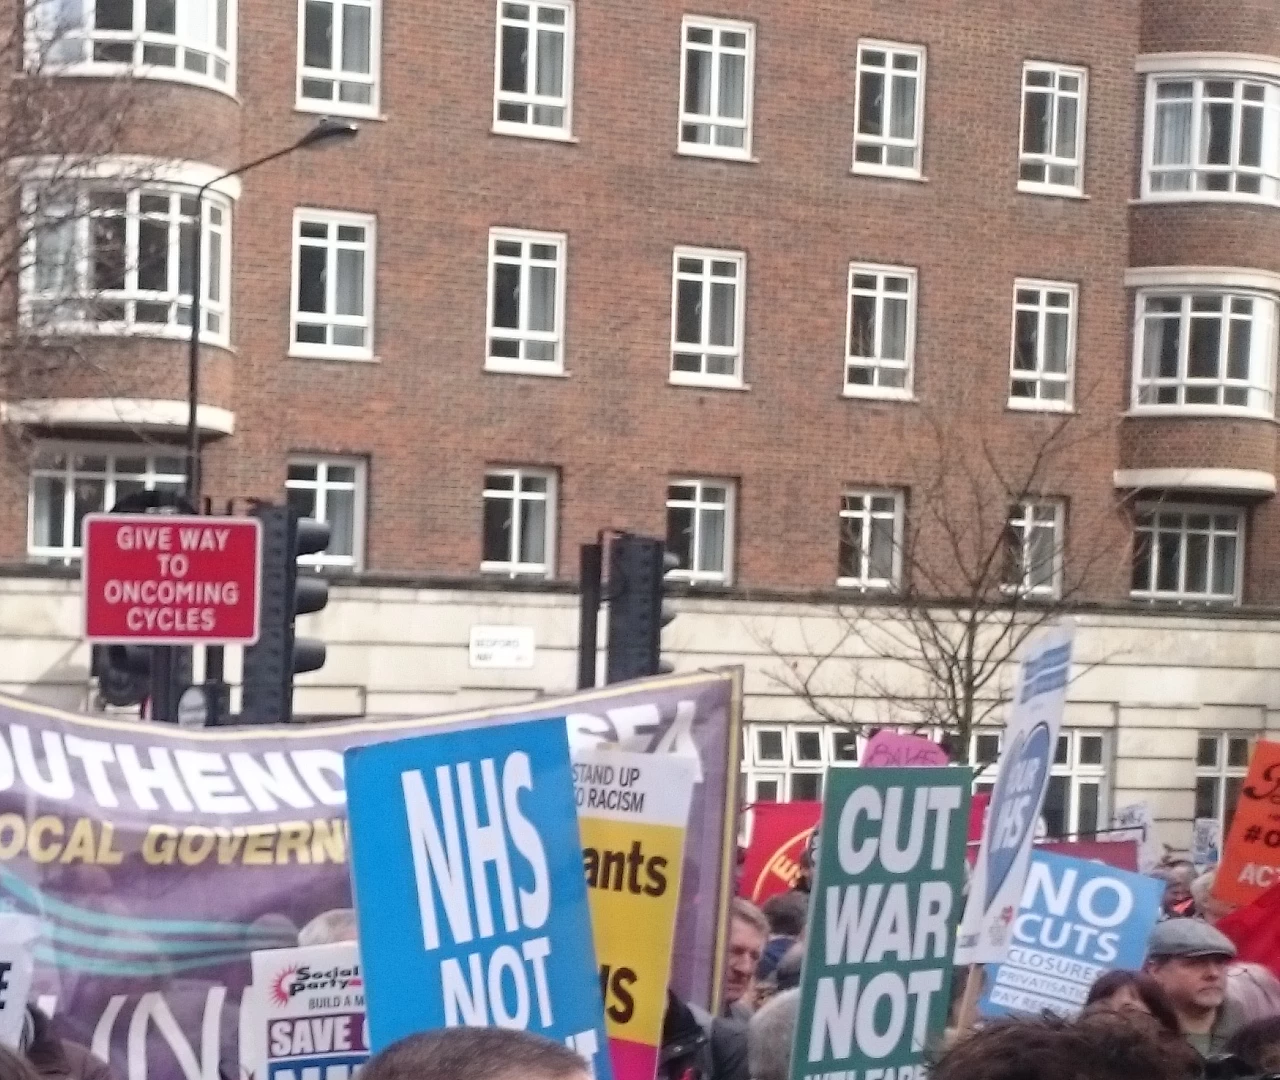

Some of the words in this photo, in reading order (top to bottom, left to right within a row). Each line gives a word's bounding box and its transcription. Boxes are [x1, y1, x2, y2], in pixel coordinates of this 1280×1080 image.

[117, 526, 172, 551] GIVE
[179, 527, 230, 551] WAY
[157, 552, 189, 578] TO
[103, 579, 240, 605] ONCOMING
[126, 606, 217, 631] CYCLES
[573, 763, 620, 786] STAND
[620, 767, 640, 787] UP
[591, 789, 645, 814] RACISM
[143, 817, 349, 866] GOVERN
[838, 784, 963, 876] CUT
[1243, 824, 1280, 849] #O
[401, 749, 551, 953] NHS
[1020, 861, 1134, 928] NO
[825, 881, 955, 967] WAR
[1012, 913, 1121, 963] CUTS
[296, 965, 359, 982] Social
[440, 937, 554, 1032] NOT
[308, 995, 342, 1010] BUILD
[344, 996, 352, 1007] A
[808, 968, 943, 1064] NOT
[270, 1016, 351, 1058] SAVE
